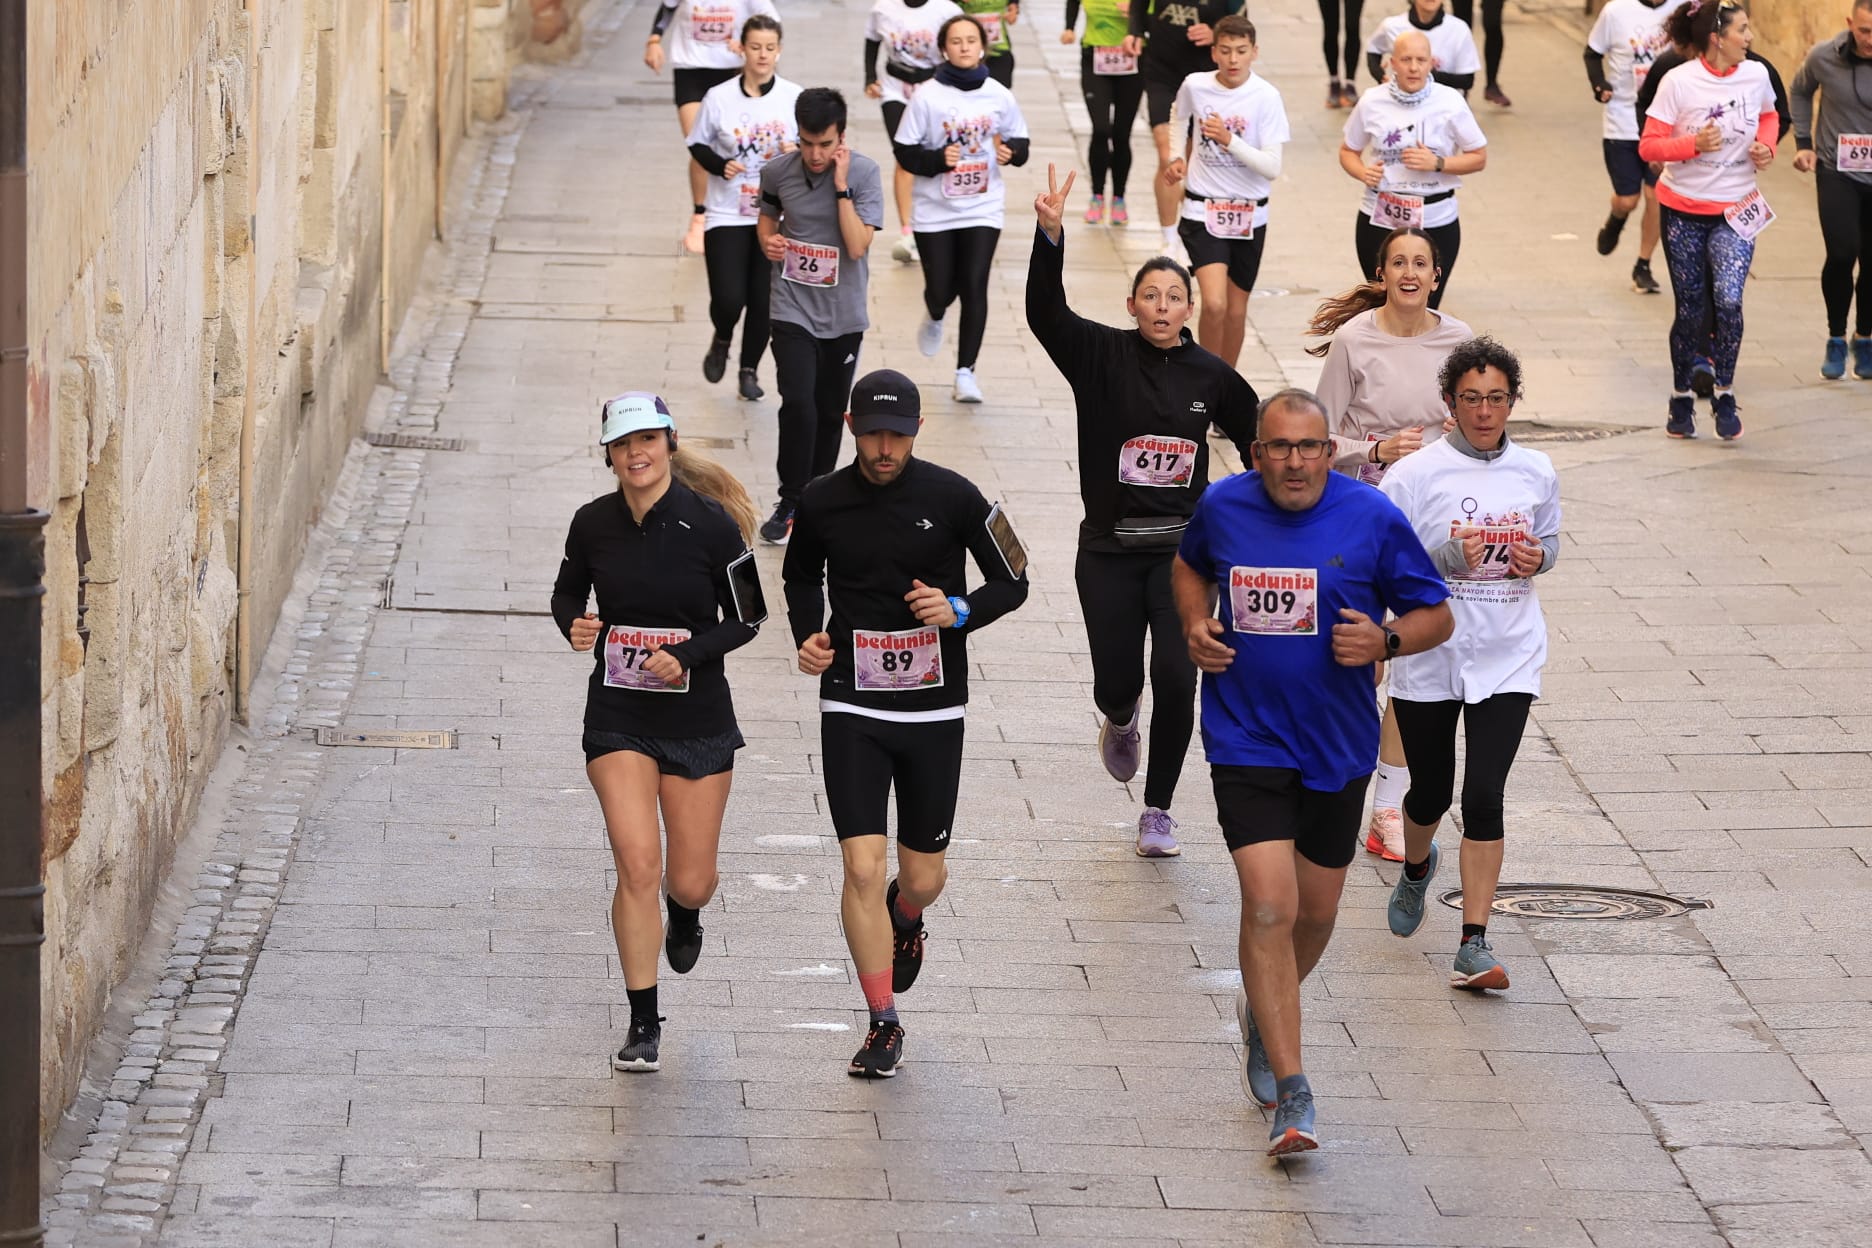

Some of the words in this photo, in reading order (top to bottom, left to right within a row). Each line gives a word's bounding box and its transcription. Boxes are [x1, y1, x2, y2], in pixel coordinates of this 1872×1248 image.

[1850, 146, 1872, 160] 69
[953, 172, 981, 186] 335
[1216, 211, 1241, 225] 591
[1384, 204, 1412, 221] 635
[1737, 203, 1760, 226] 589
[799, 256, 818, 272] 26
[873, 394, 898, 402] KIPRUN
[1136, 451, 1180, 471] 617
[1232, 571, 1315, 590] bedunia
[1462, 587, 1485, 595] MAYOR
[1247, 589, 1296, 614] 309
[855, 631, 937, 650] bedunia
[882, 650, 914, 672] 89
